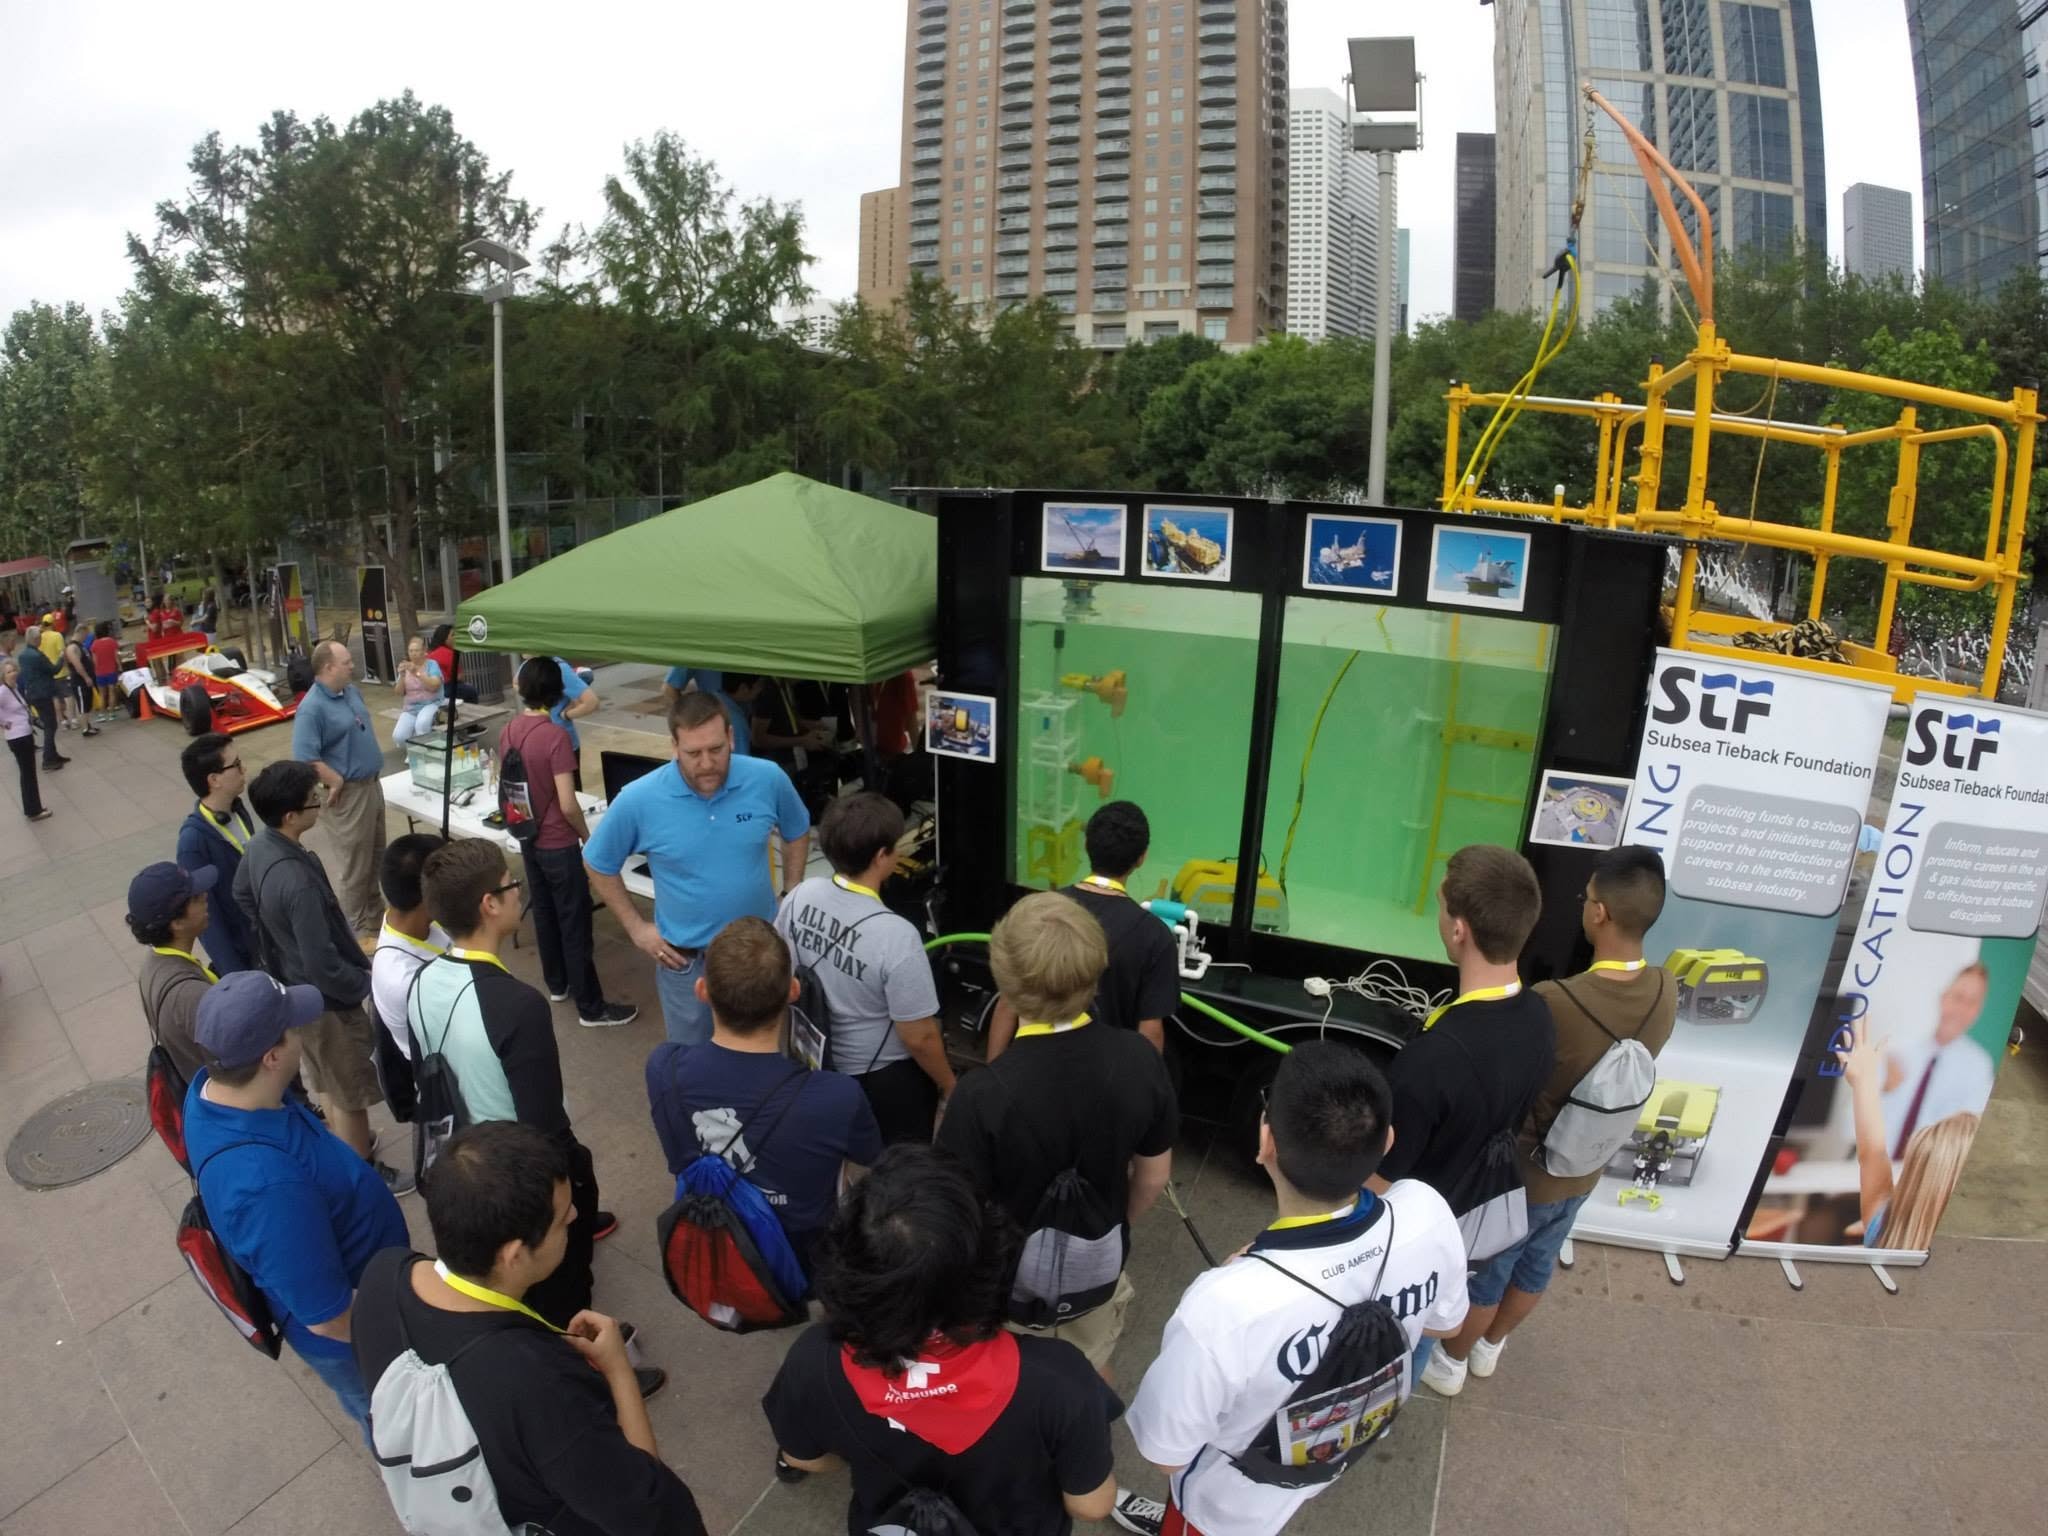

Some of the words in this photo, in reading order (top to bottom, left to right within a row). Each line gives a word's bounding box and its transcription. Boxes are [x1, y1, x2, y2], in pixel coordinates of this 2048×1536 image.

[1647, 730, 1711, 753] Subsea
[1716, 740, 1780, 765] Tieback
[1783, 751, 1872, 779] Foundation
[1900, 772, 1950, 793] Subsea
[1954, 778, 2002, 799] Tieback
[1691, 799, 1756, 823] Providing
[1758, 810, 1794, 826] funds
[1796, 816, 1810, 829] to
[1811, 820, 1855, 834] school
[1682, 819, 1739, 836] projects
[1741, 828, 1766, 839] and
[1766, 829, 1826, 849] initiatives
[1827, 839, 1854, 853] that
[1681, 837, 1734, 853] support
[1735, 844, 1756, 856] the
[1758, 847, 1832, 867] introduction
[1834, 859, 1850, 870] of
[1684, 856, 1734, 872] careers
[1735, 861, 1751, 873] in
[1751, 864, 1772, 877] the
[1773, 868, 1825, 885] offshore
[1826, 874, 1838, 885] &
[1925, 856, 1972, 871] promote
[1705, 876, 1753, 890] subsea
[1755, 882, 1808, 900] industry.
[1924, 889, 1936, 900] to
[1937, 890, 1983, 905] offshore
[798, 904, 826, 932] ALL
[829, 917, 862, 953] DAY
[1818, 802, 1927, 1079] EDUCATION
[834, 946, 868, 981] DAY
[1321, 1263, 1346, 1280] CLUB
[1348, 1245, 1384, 1269] AMERICA
